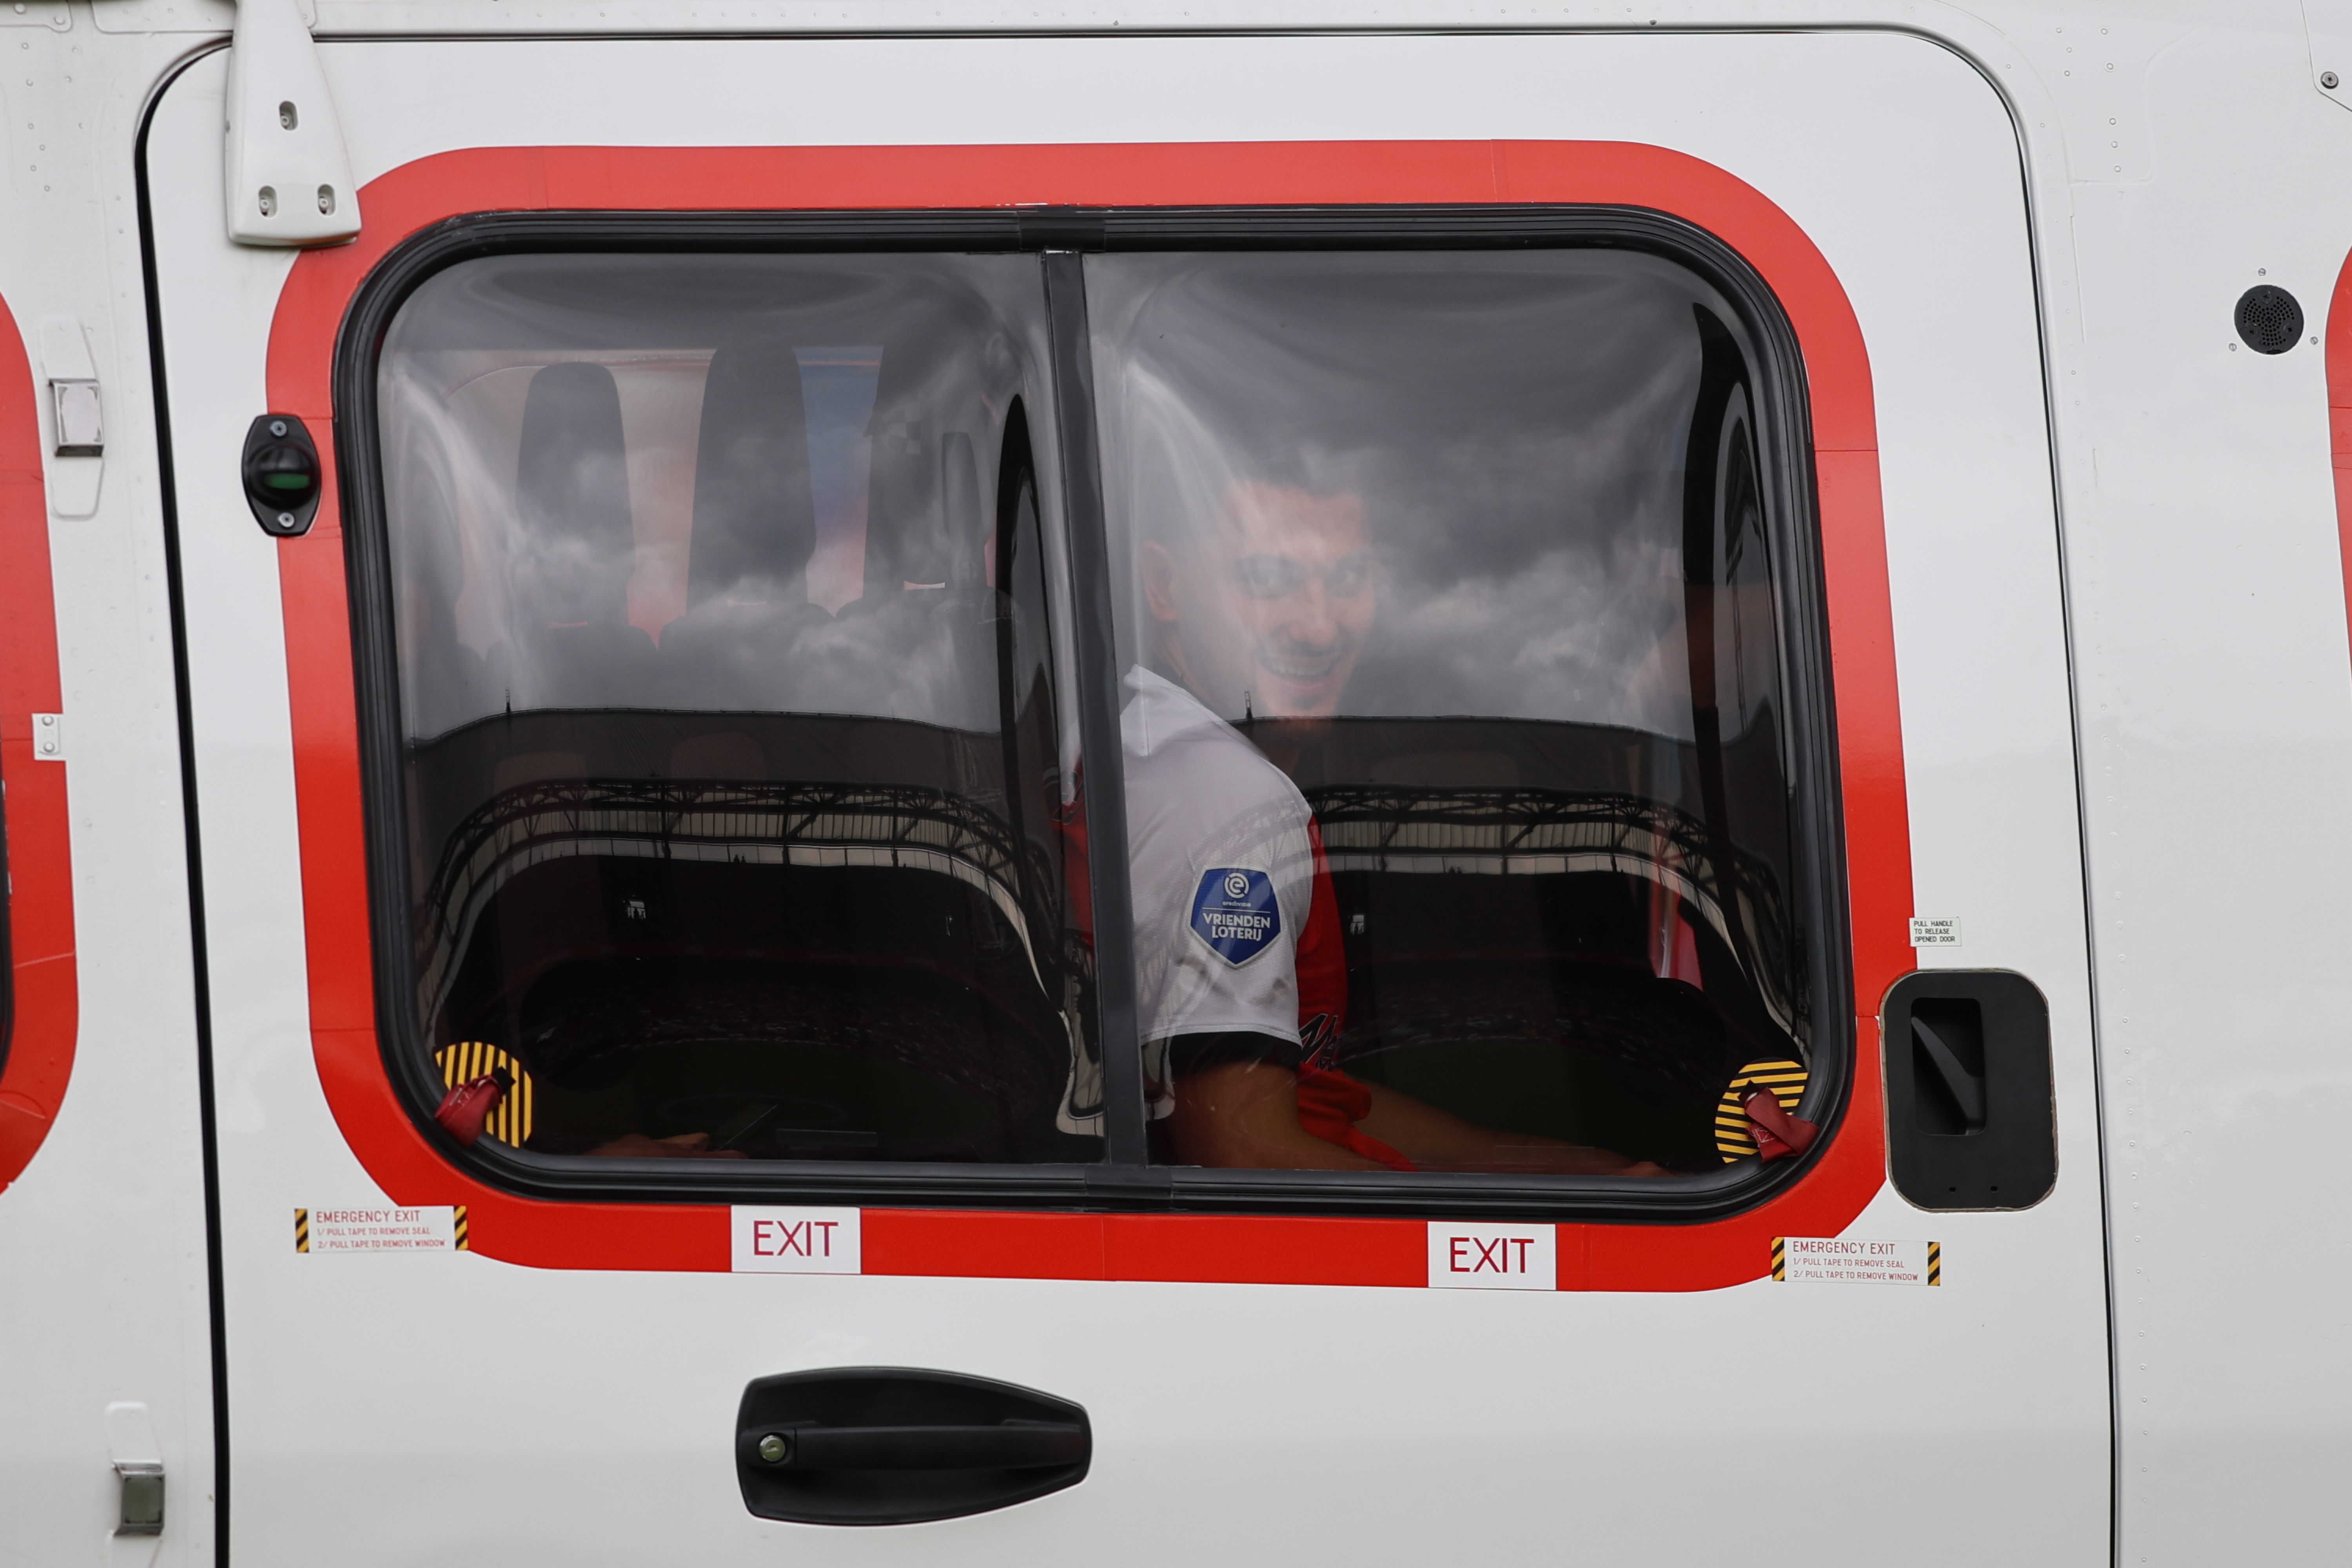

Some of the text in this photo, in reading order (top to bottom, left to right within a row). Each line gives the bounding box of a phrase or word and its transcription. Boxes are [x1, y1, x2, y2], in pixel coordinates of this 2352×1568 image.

[1203, 913, 1270, 928] VRIENDEN
[1212, 926, 1262, 941] LOTERIJ
[316, 1210, 420, 1223] EMERGENCY EXIT
[754, 1221, 838, 1256] EXIT
[1450, 1237, 1534, 1273] EXIT
[1793, 1241, 1895, 1254] EMERGENCY EXIT
